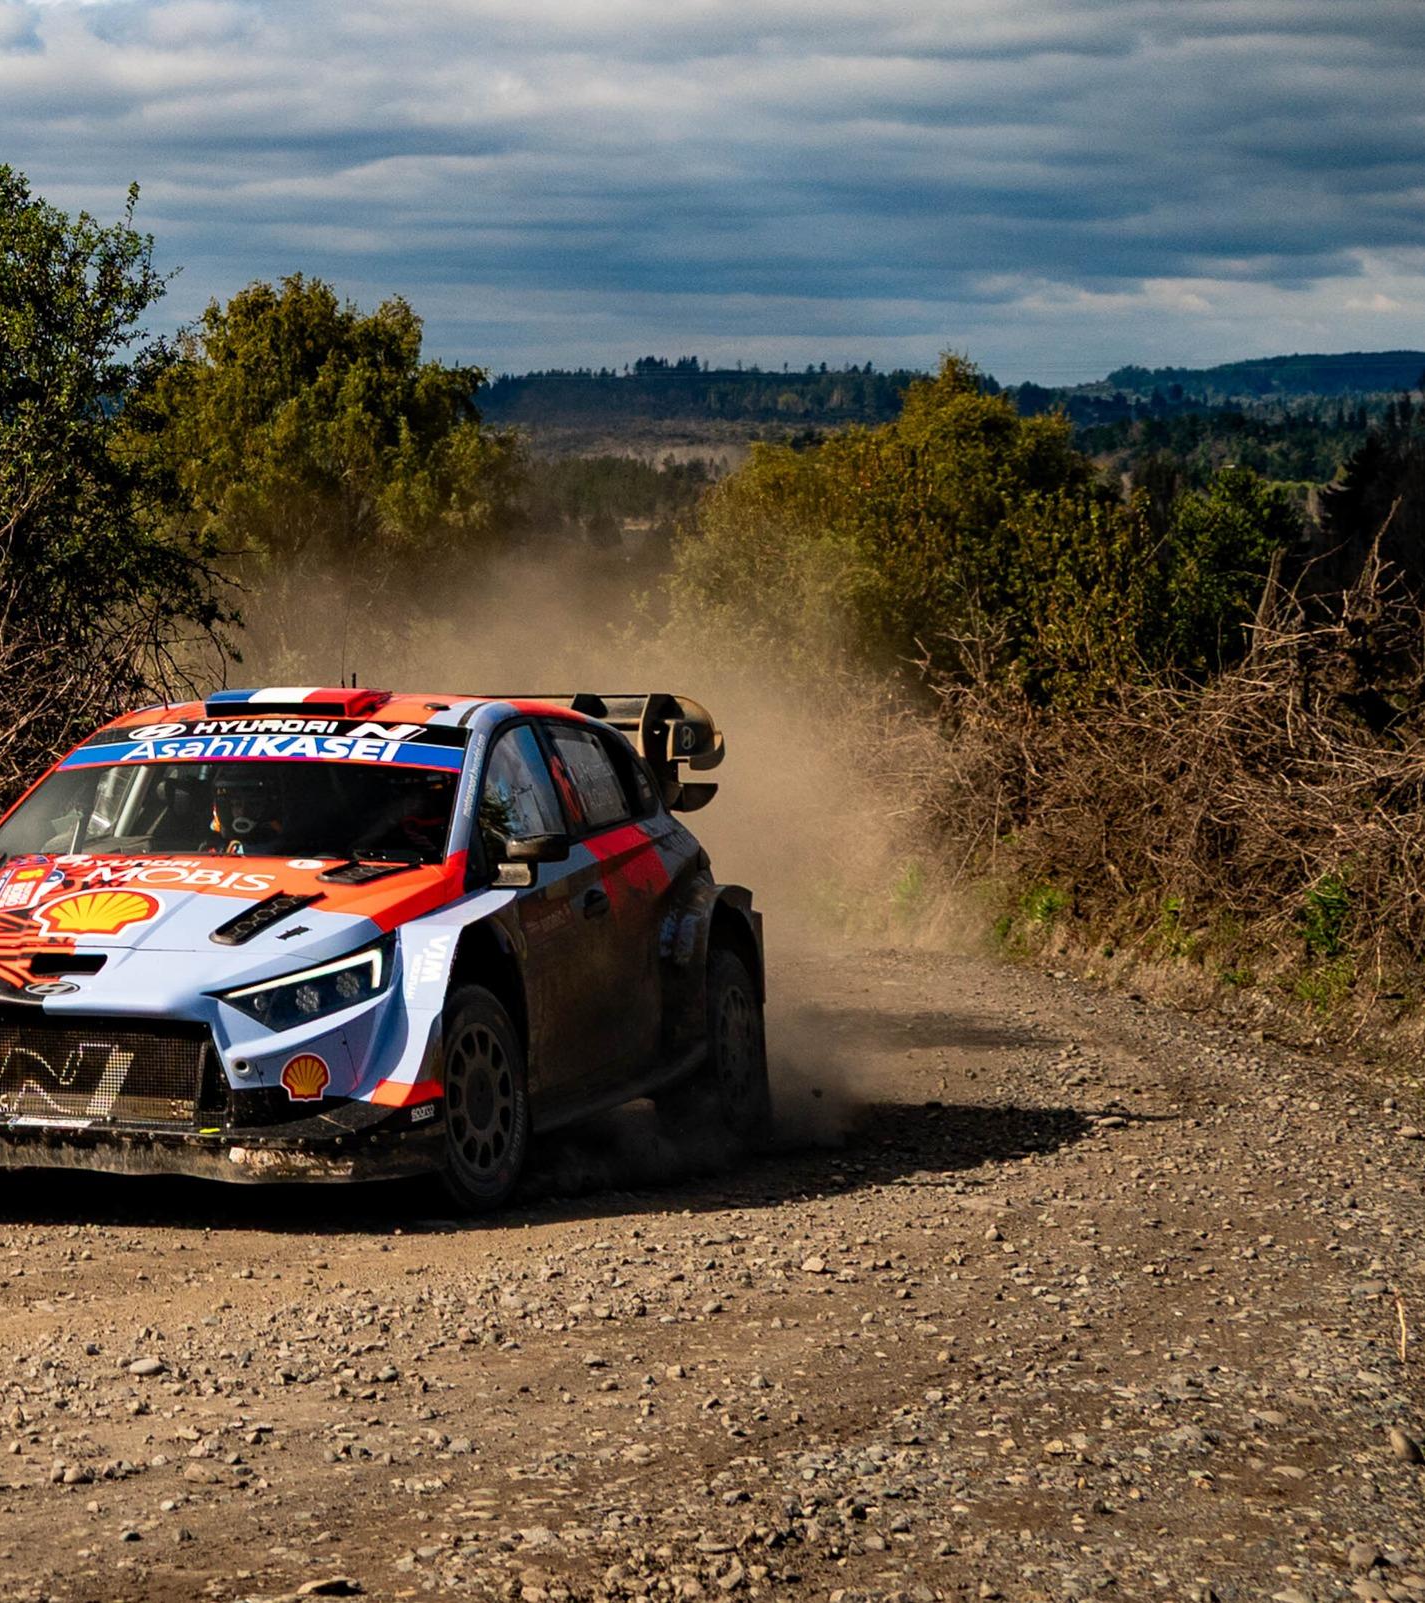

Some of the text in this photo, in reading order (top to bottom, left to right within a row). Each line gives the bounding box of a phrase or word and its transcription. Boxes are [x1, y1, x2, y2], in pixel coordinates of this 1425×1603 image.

[193, 719, 339, 735] HYUNDAI
[119, 736, 402, 762] AsahiKASEI
[81, 866, 276, 892] MOBIS
